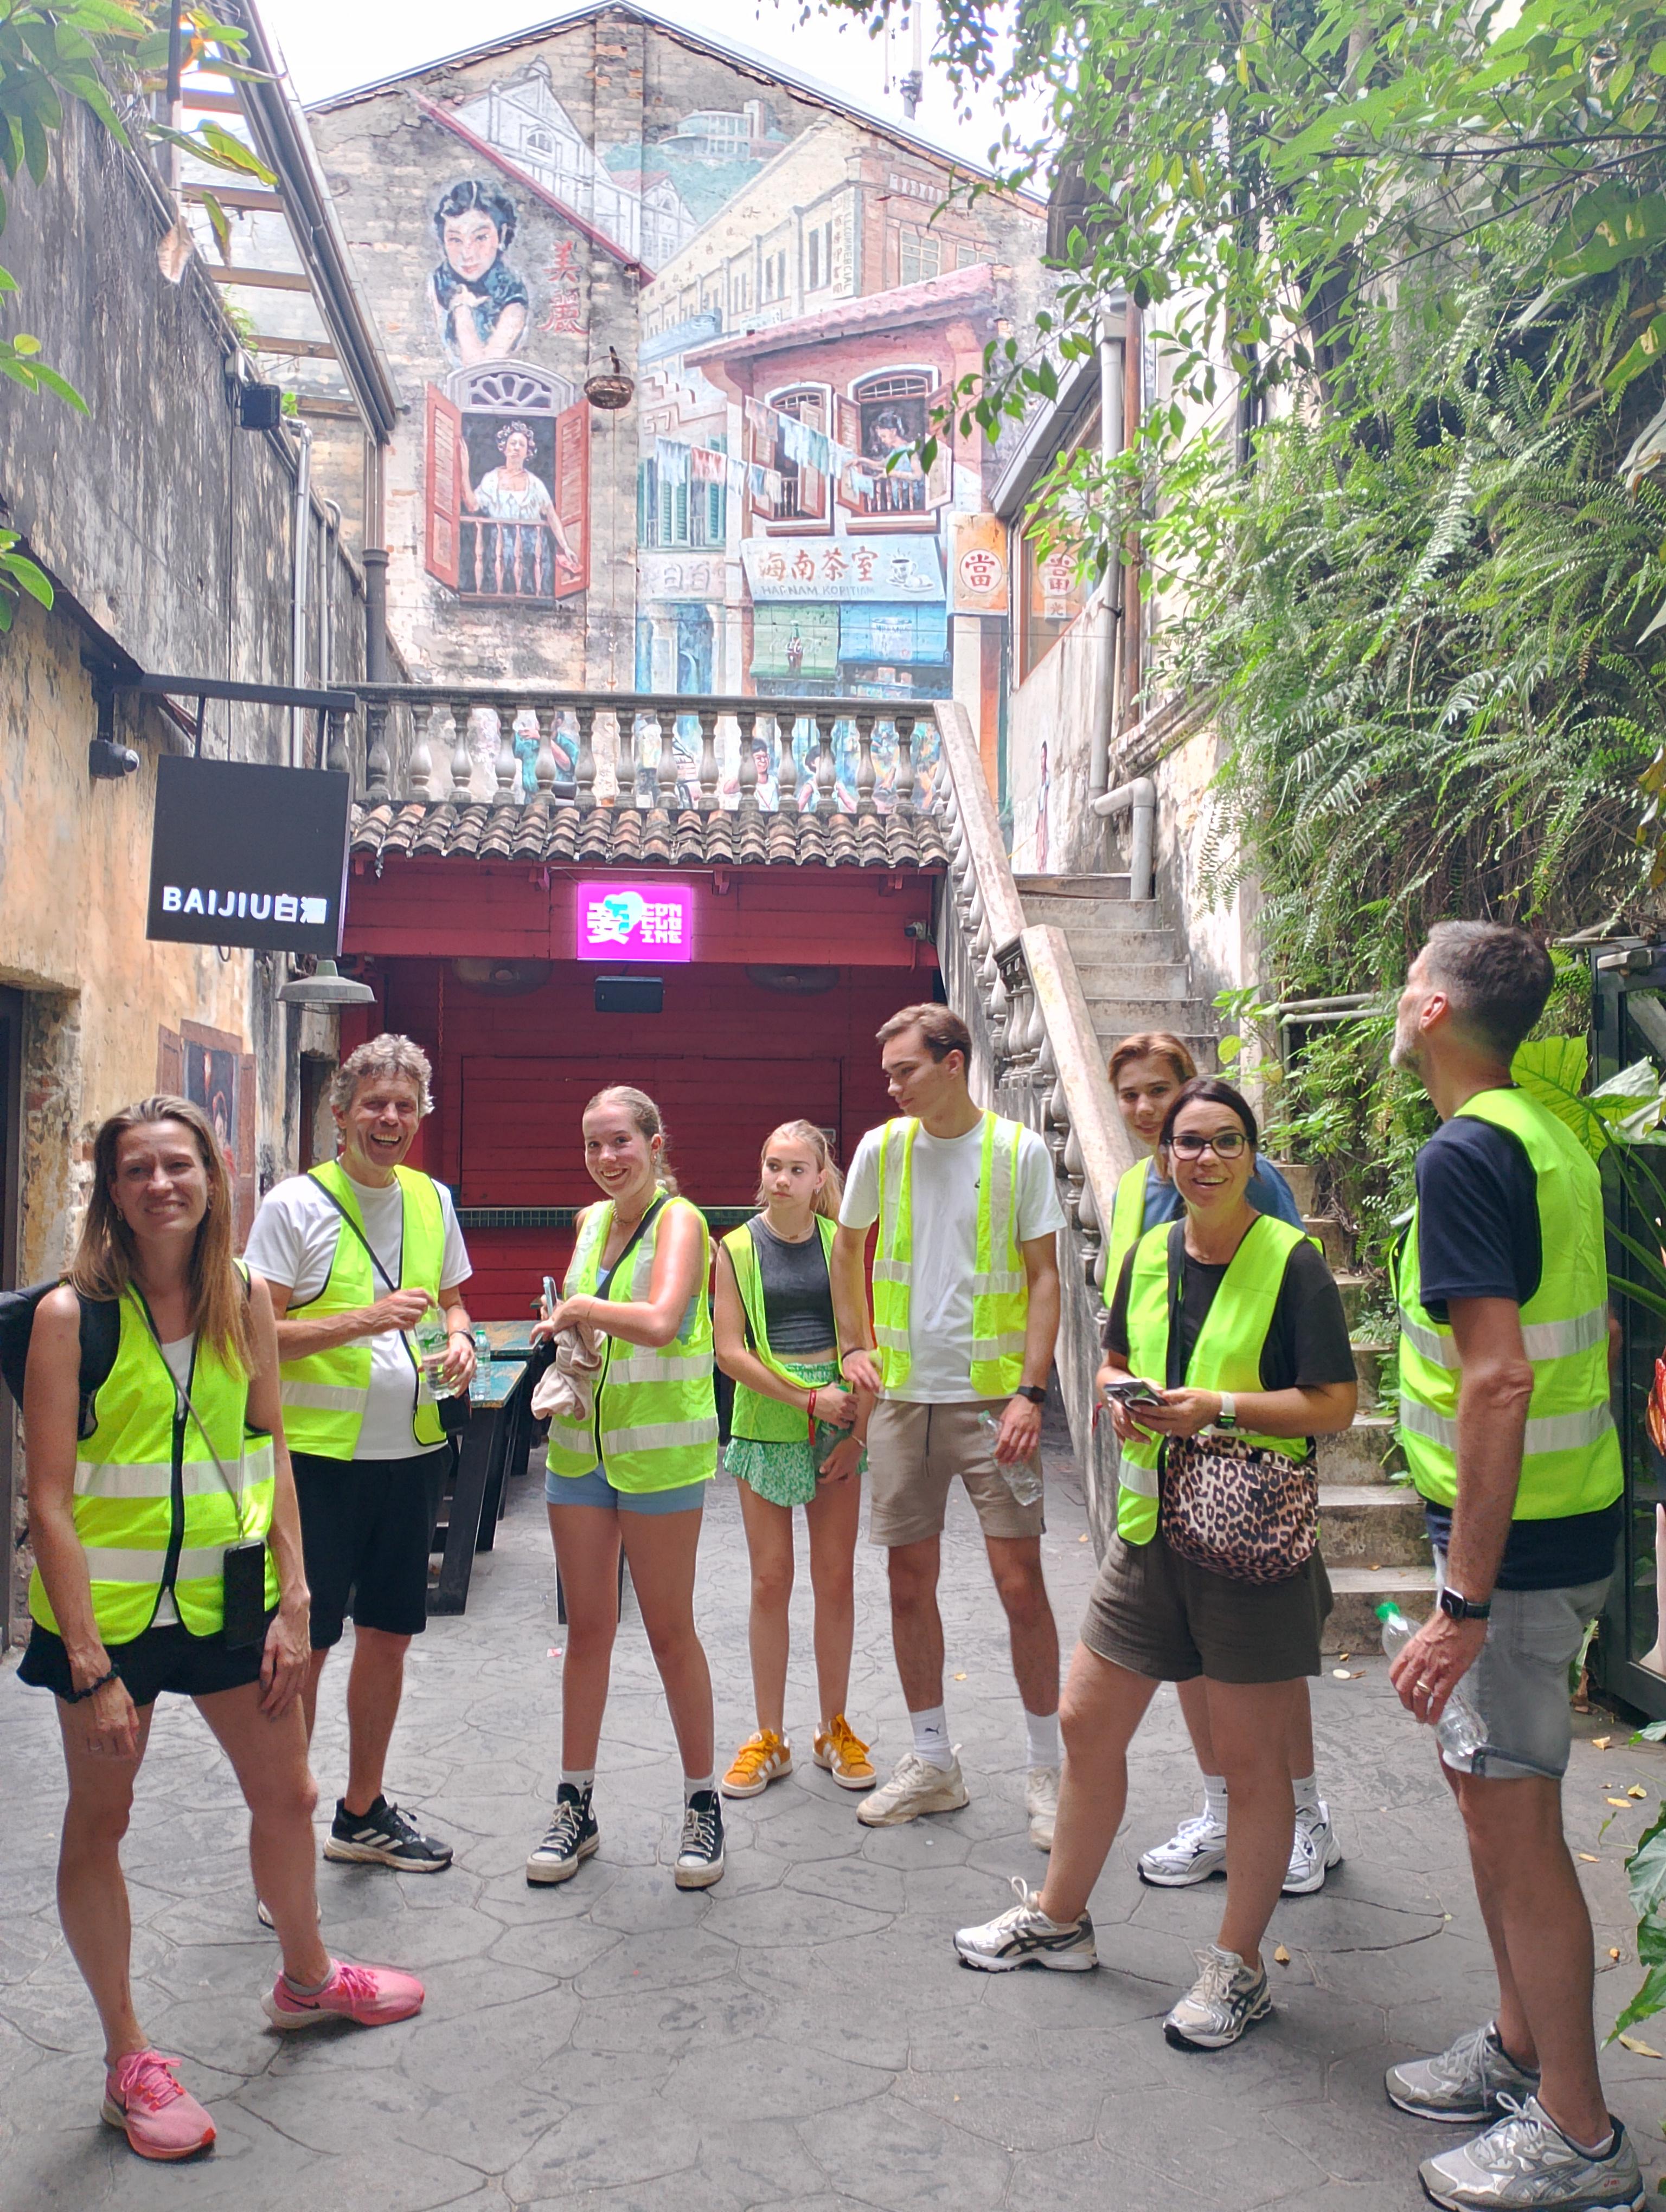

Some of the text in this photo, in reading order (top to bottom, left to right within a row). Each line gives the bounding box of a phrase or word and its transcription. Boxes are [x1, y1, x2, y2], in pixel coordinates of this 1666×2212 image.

[760, 545, 879, 582] 海南茶室
[965, 554, 996, 587] 當
[163, 886, 271, 920] BAIJIU
